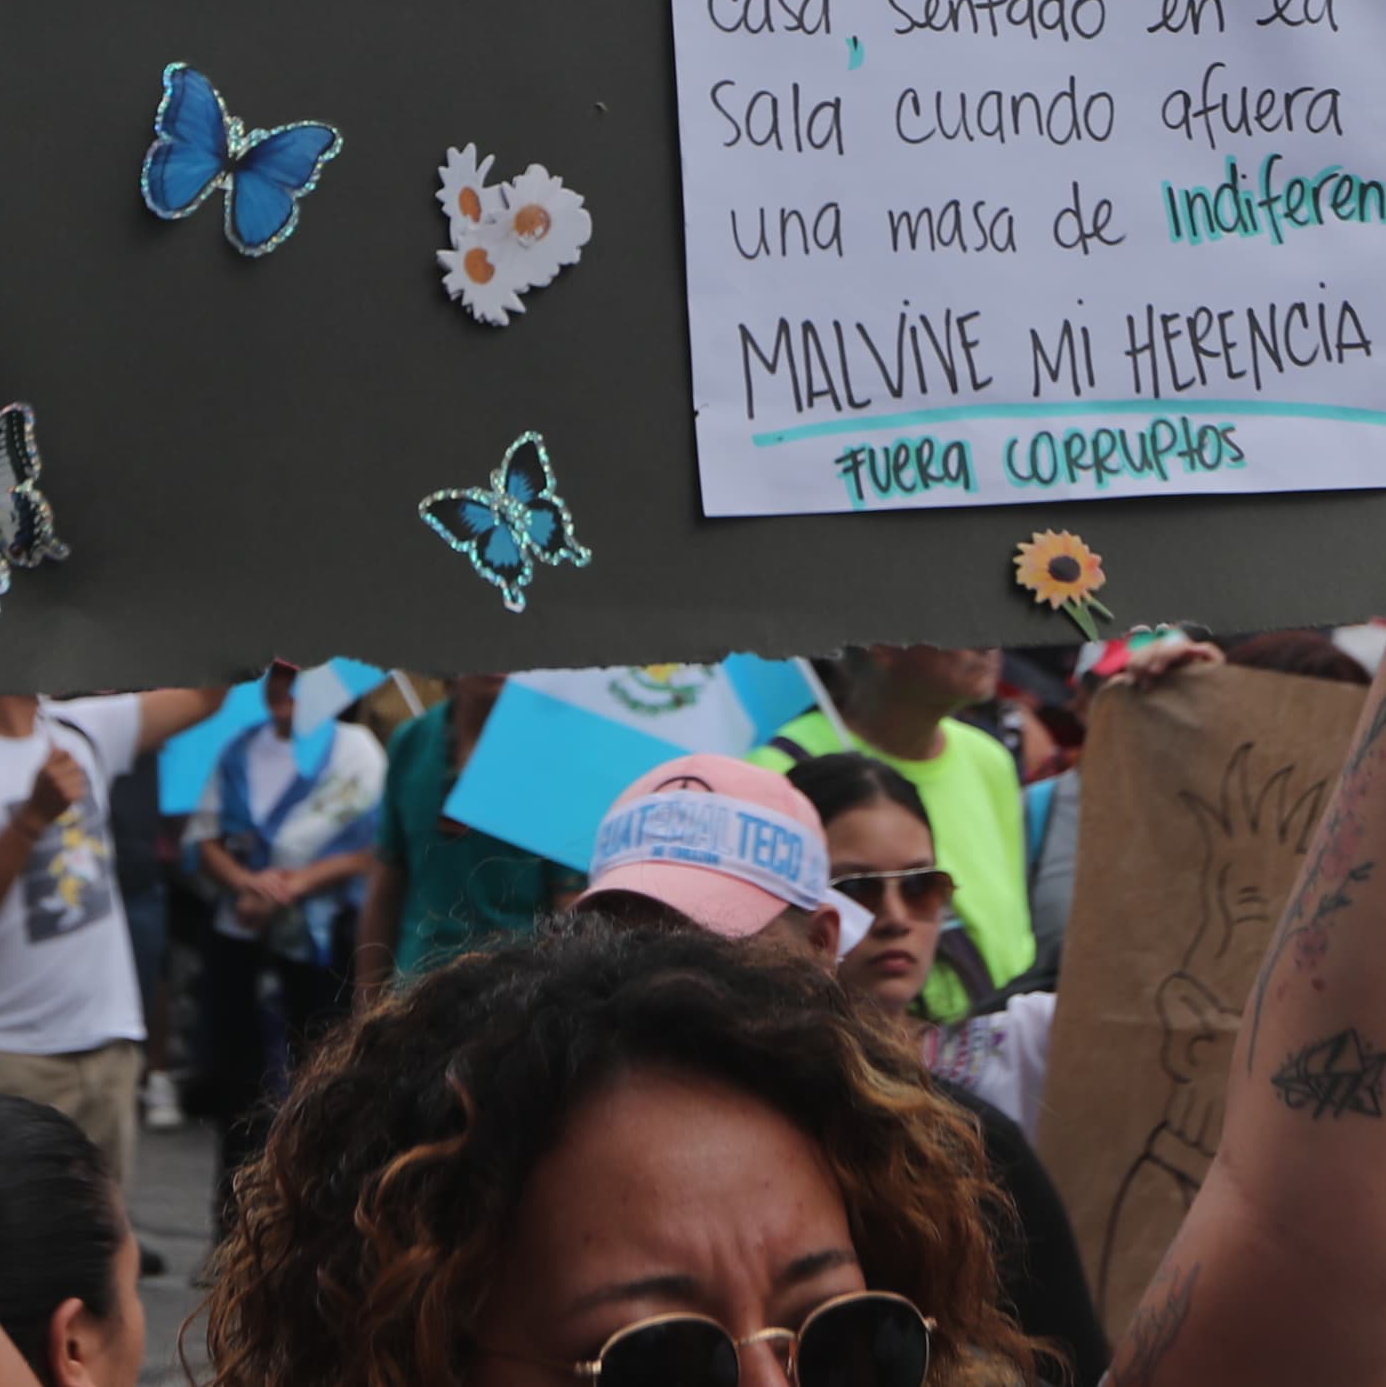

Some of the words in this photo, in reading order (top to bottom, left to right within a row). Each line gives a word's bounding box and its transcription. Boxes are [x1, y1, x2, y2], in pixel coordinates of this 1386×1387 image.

[896, 75, 1115, 145] cuando
[1161, 62, 1343, 150] afuera
[731, 199, 844, 260] una
[888, 197, 1016, 255] masa
[1053, 181, 1126, 255] de
[739, 300, 992, 419] MALVIVE
[1030, 299, 1095, 397] MI
